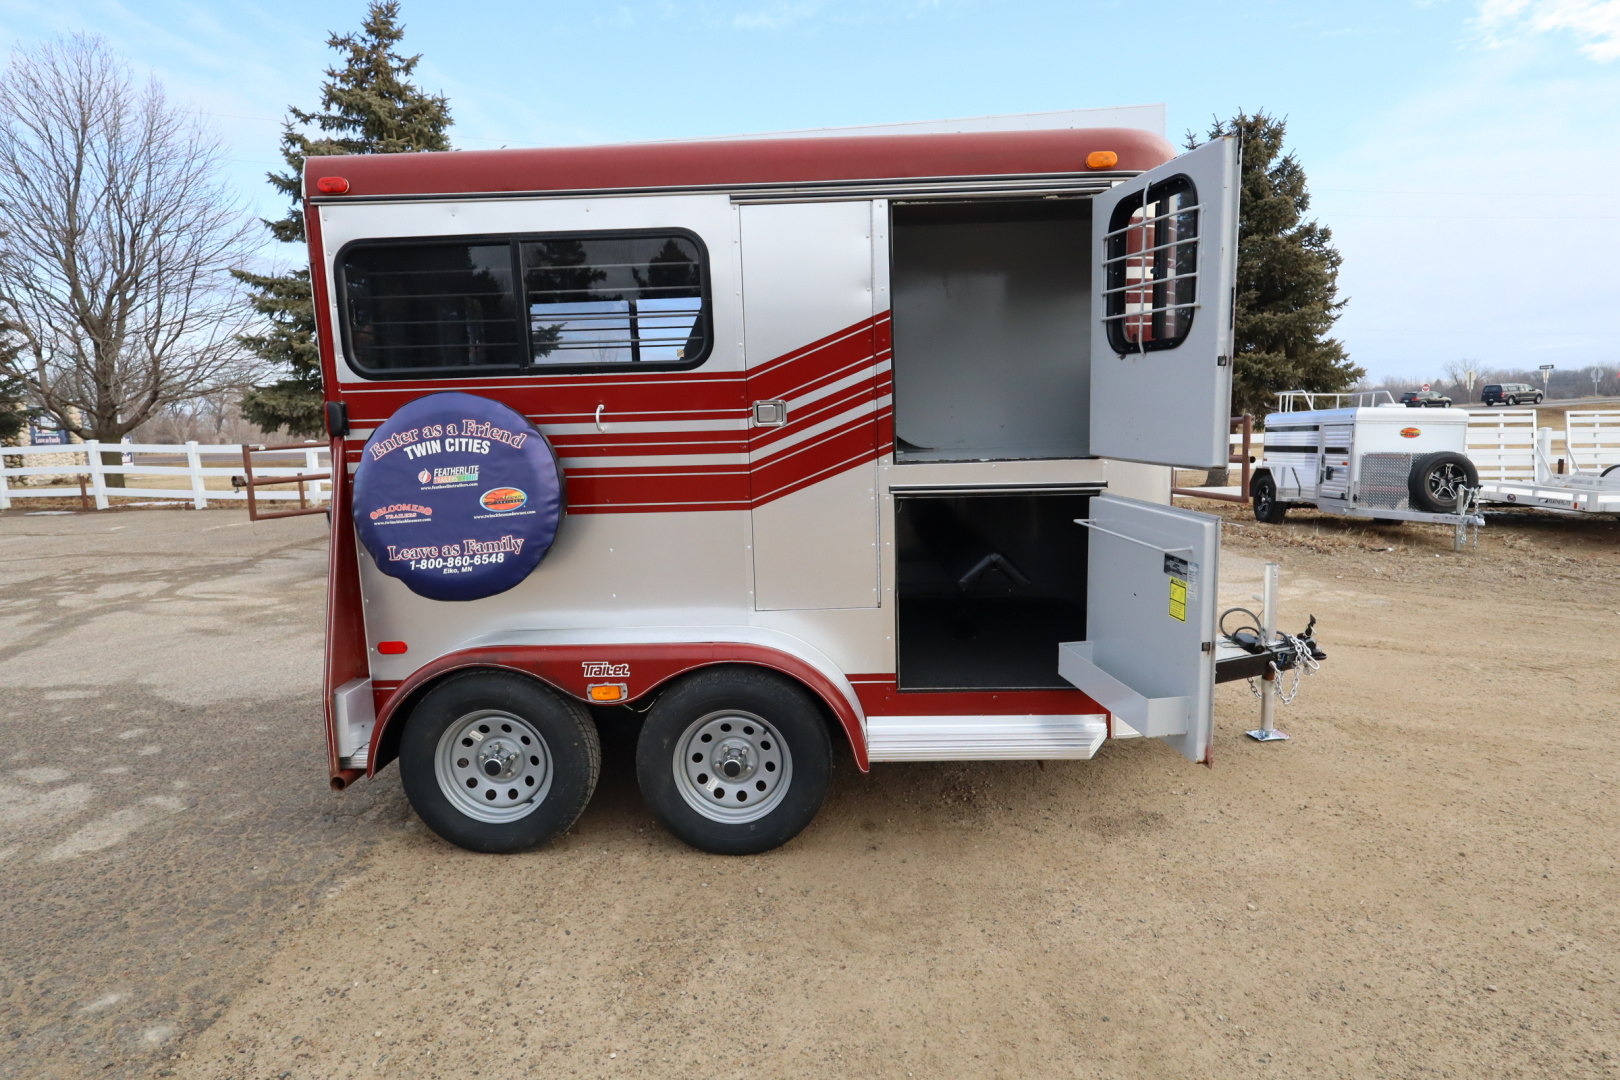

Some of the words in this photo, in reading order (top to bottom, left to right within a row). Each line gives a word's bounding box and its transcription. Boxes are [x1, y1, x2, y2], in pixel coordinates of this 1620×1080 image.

[369, 429, 418, 461] Enter
[423, 424, 442, 438] as
[446, 423, 458, 435] a
[462, 419, 527, 449] Friend
[404, 439, 441, 460] TWIN
[445, 438, 490, 454] CITIES
[434, 465, 480, 476] FEATHERLITE
[387, 545, 438, 561] Leave
[441, 544, 460, 557] as
[463, 534, 525, 555] Family
[409, 553, 505, 570] 1-800-860-6548
[443, 567, 460, 575] Elko,
